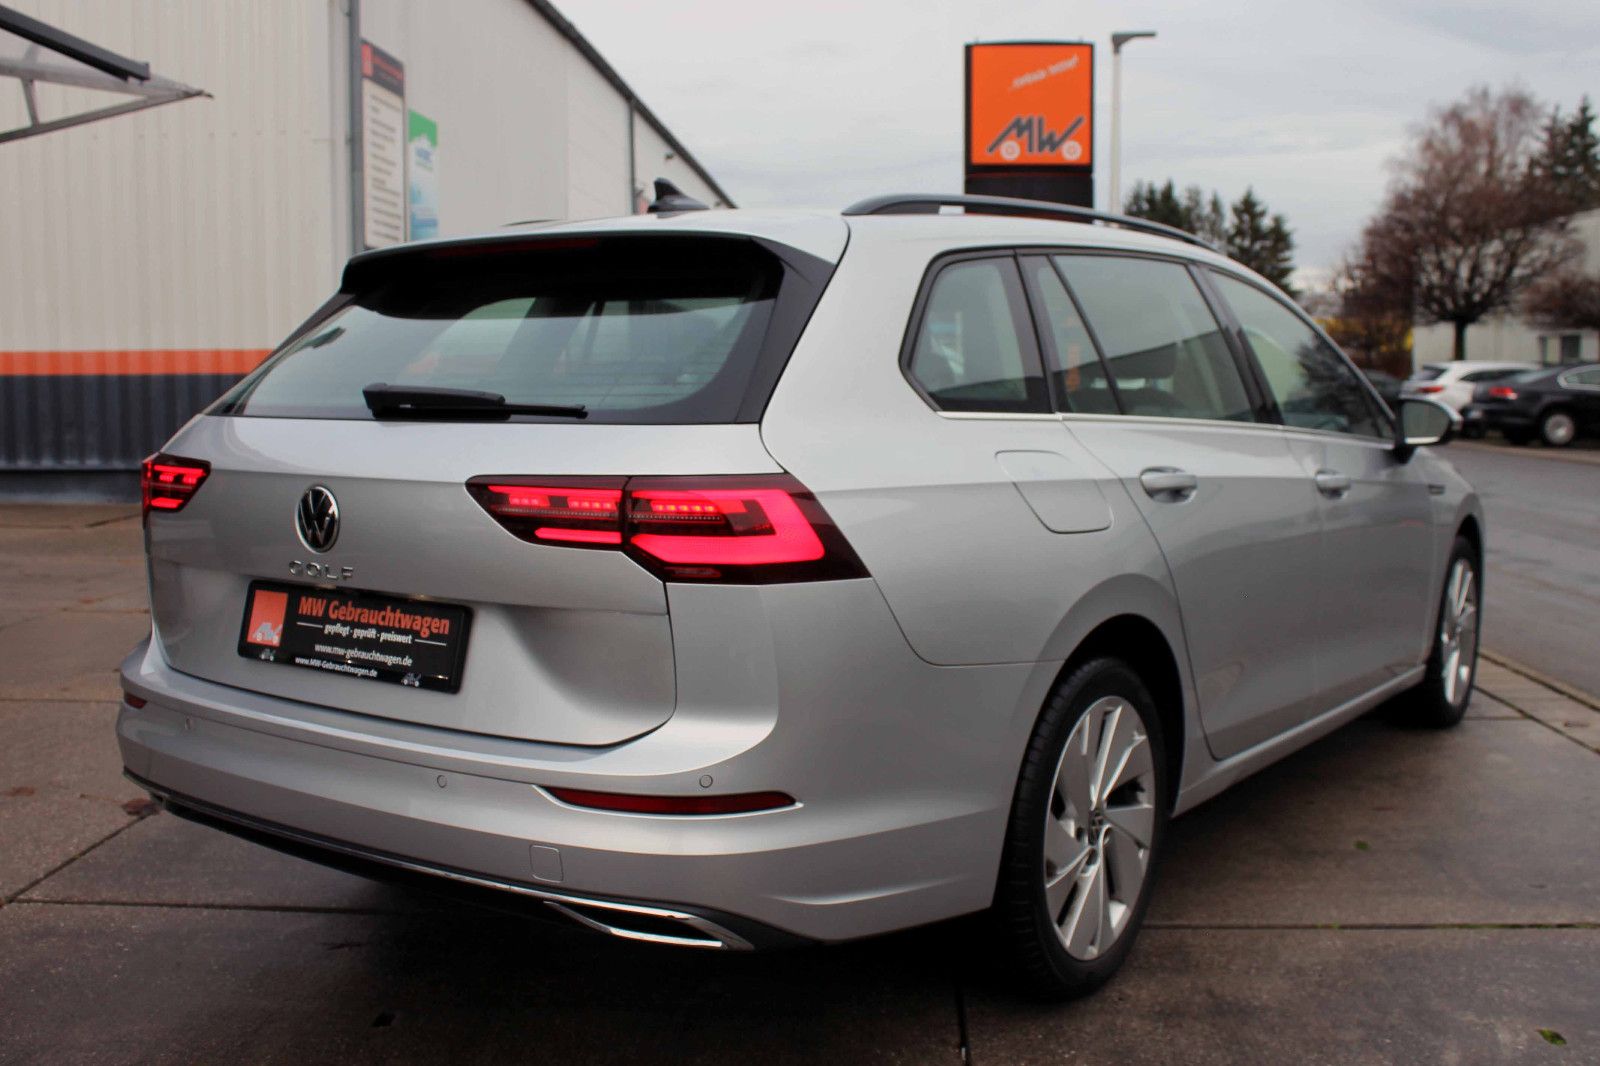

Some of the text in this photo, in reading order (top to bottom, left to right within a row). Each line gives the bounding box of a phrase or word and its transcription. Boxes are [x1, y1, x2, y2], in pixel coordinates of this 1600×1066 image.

[288, 560, 354, 580] GOLF
[298, 596, 450, 638] MW Gebrauchtwagen
[324, 623, 350, 637] gepflegt
[380, 631, 412, 644] preiswert
[315, 643, 413, 667] www.mw-gebrauchtwagen.de
[294, 656, 378, 678] www.MW-Gebrauchtwagen.de
